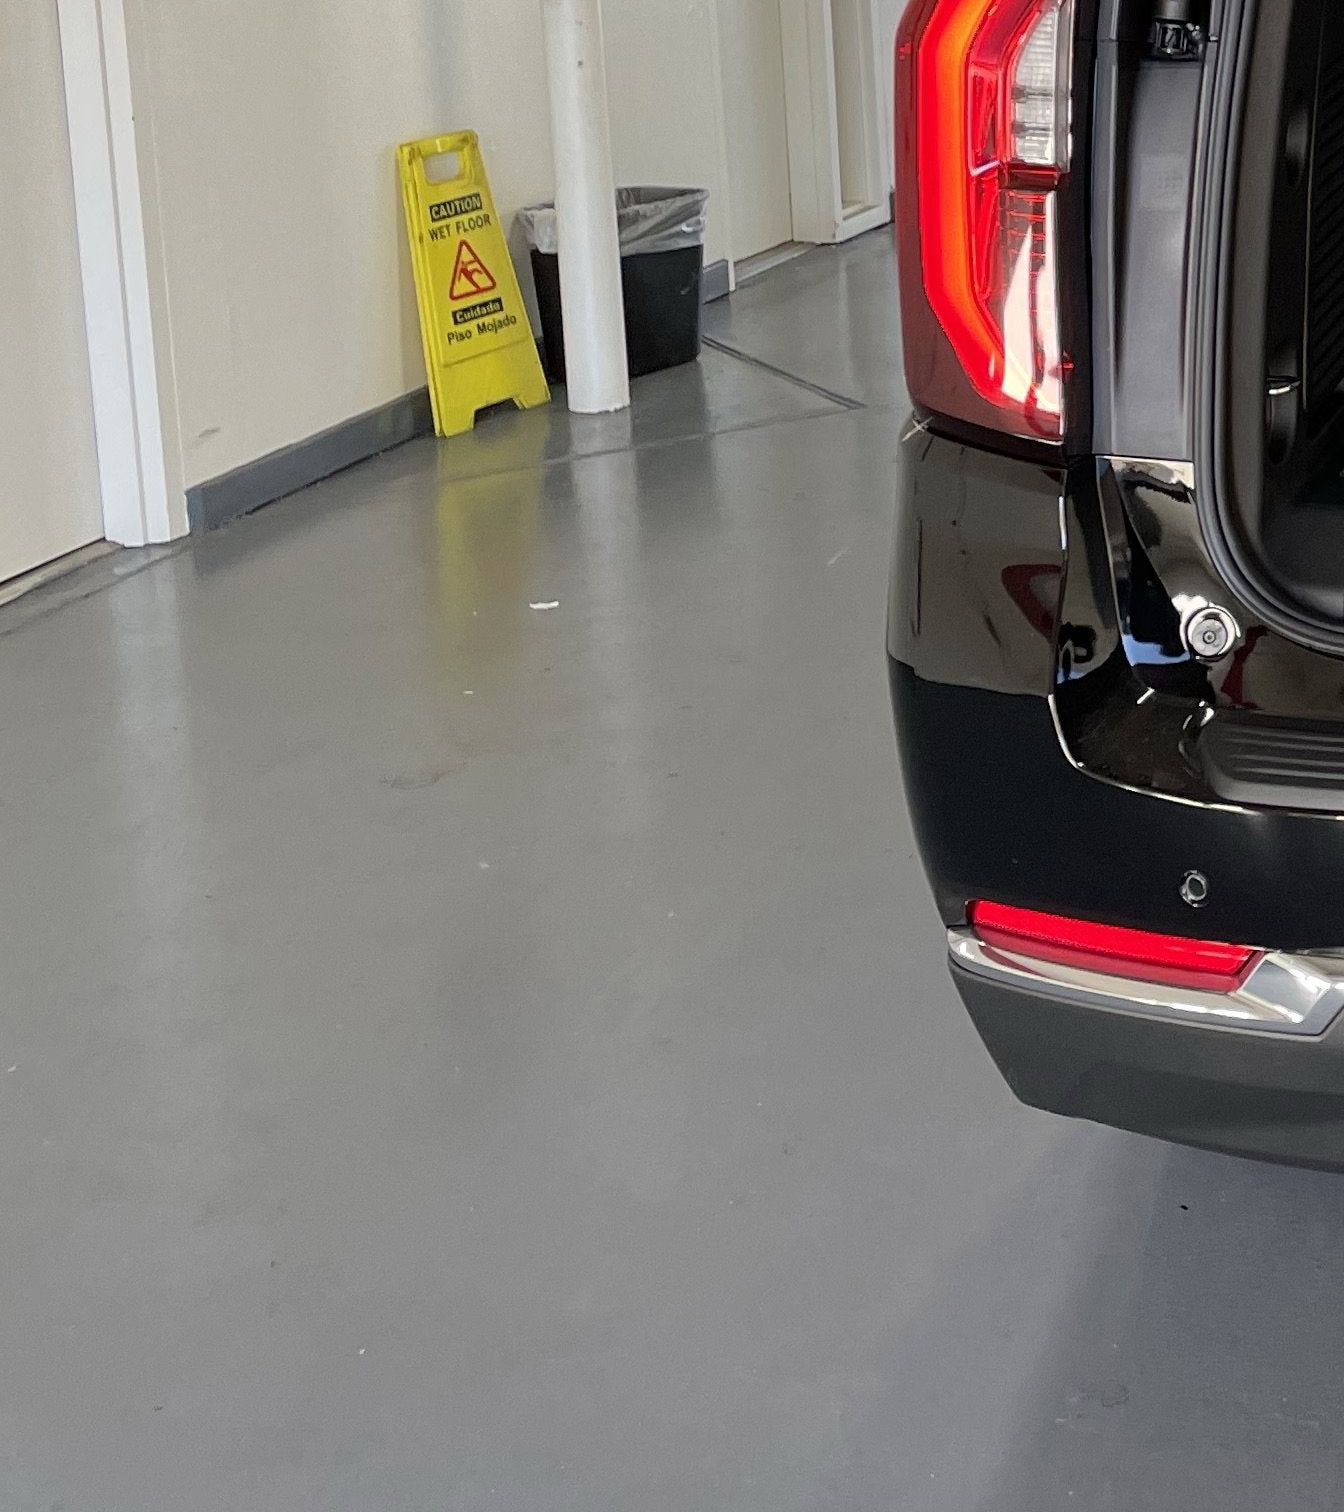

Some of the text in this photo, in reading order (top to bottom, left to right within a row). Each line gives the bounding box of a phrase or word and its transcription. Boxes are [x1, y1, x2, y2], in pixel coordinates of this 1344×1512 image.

[431, 196, 481, 220] CAUTION
[428, 213, 492, 242] WET FLOOR
[455, 301, 501, 322] Cuidado
[447, 314, 517, 345] Piso Mojado
